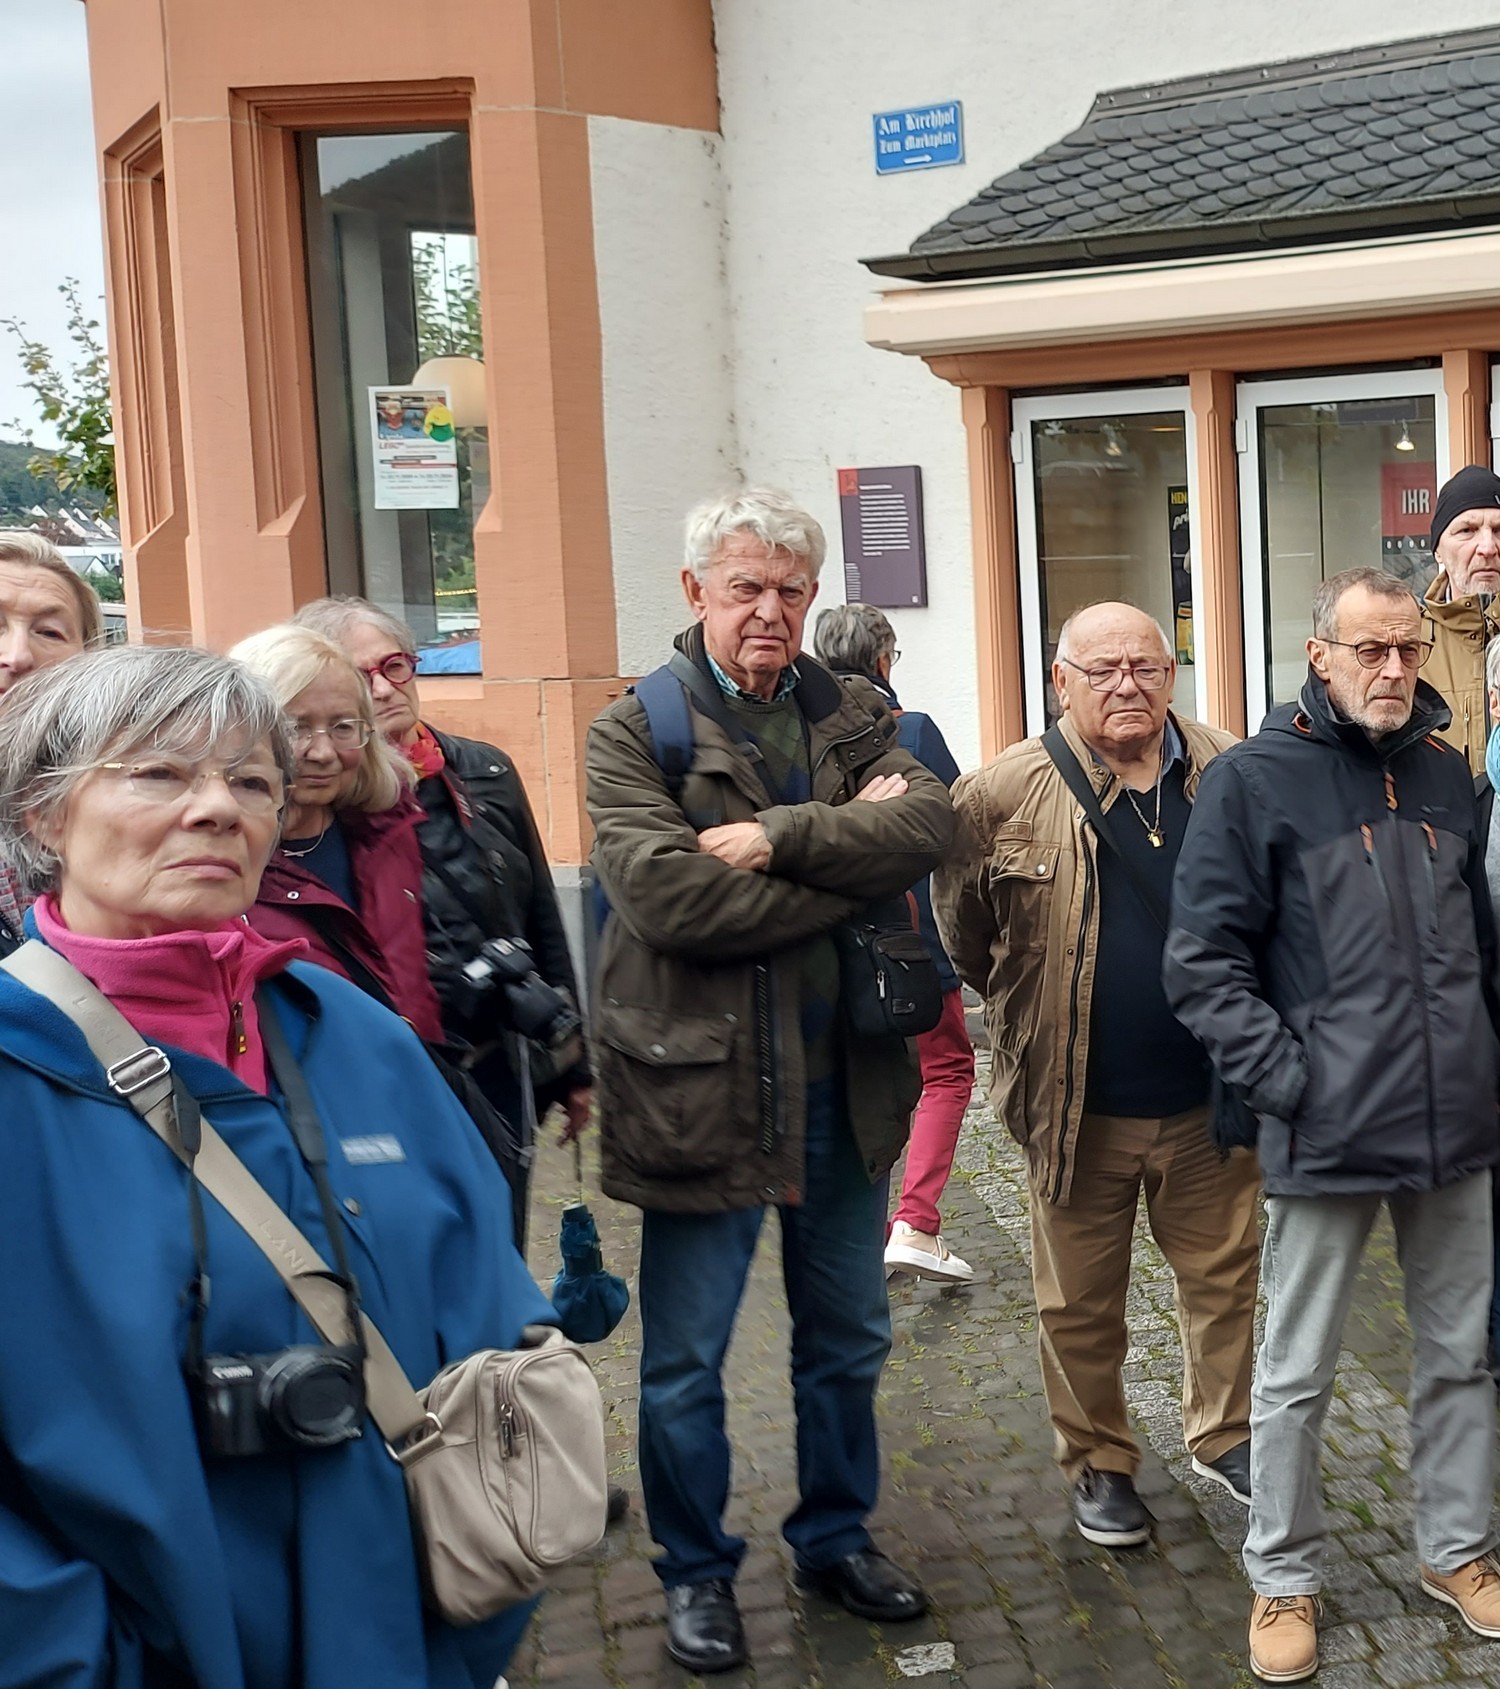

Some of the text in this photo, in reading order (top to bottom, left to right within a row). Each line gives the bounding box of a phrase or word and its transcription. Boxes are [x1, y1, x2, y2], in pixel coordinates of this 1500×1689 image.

[879, 117, 901, 136] Am
[880, 139, 901, 154] Zum
[1402, 488, 1430, 515] IHR
